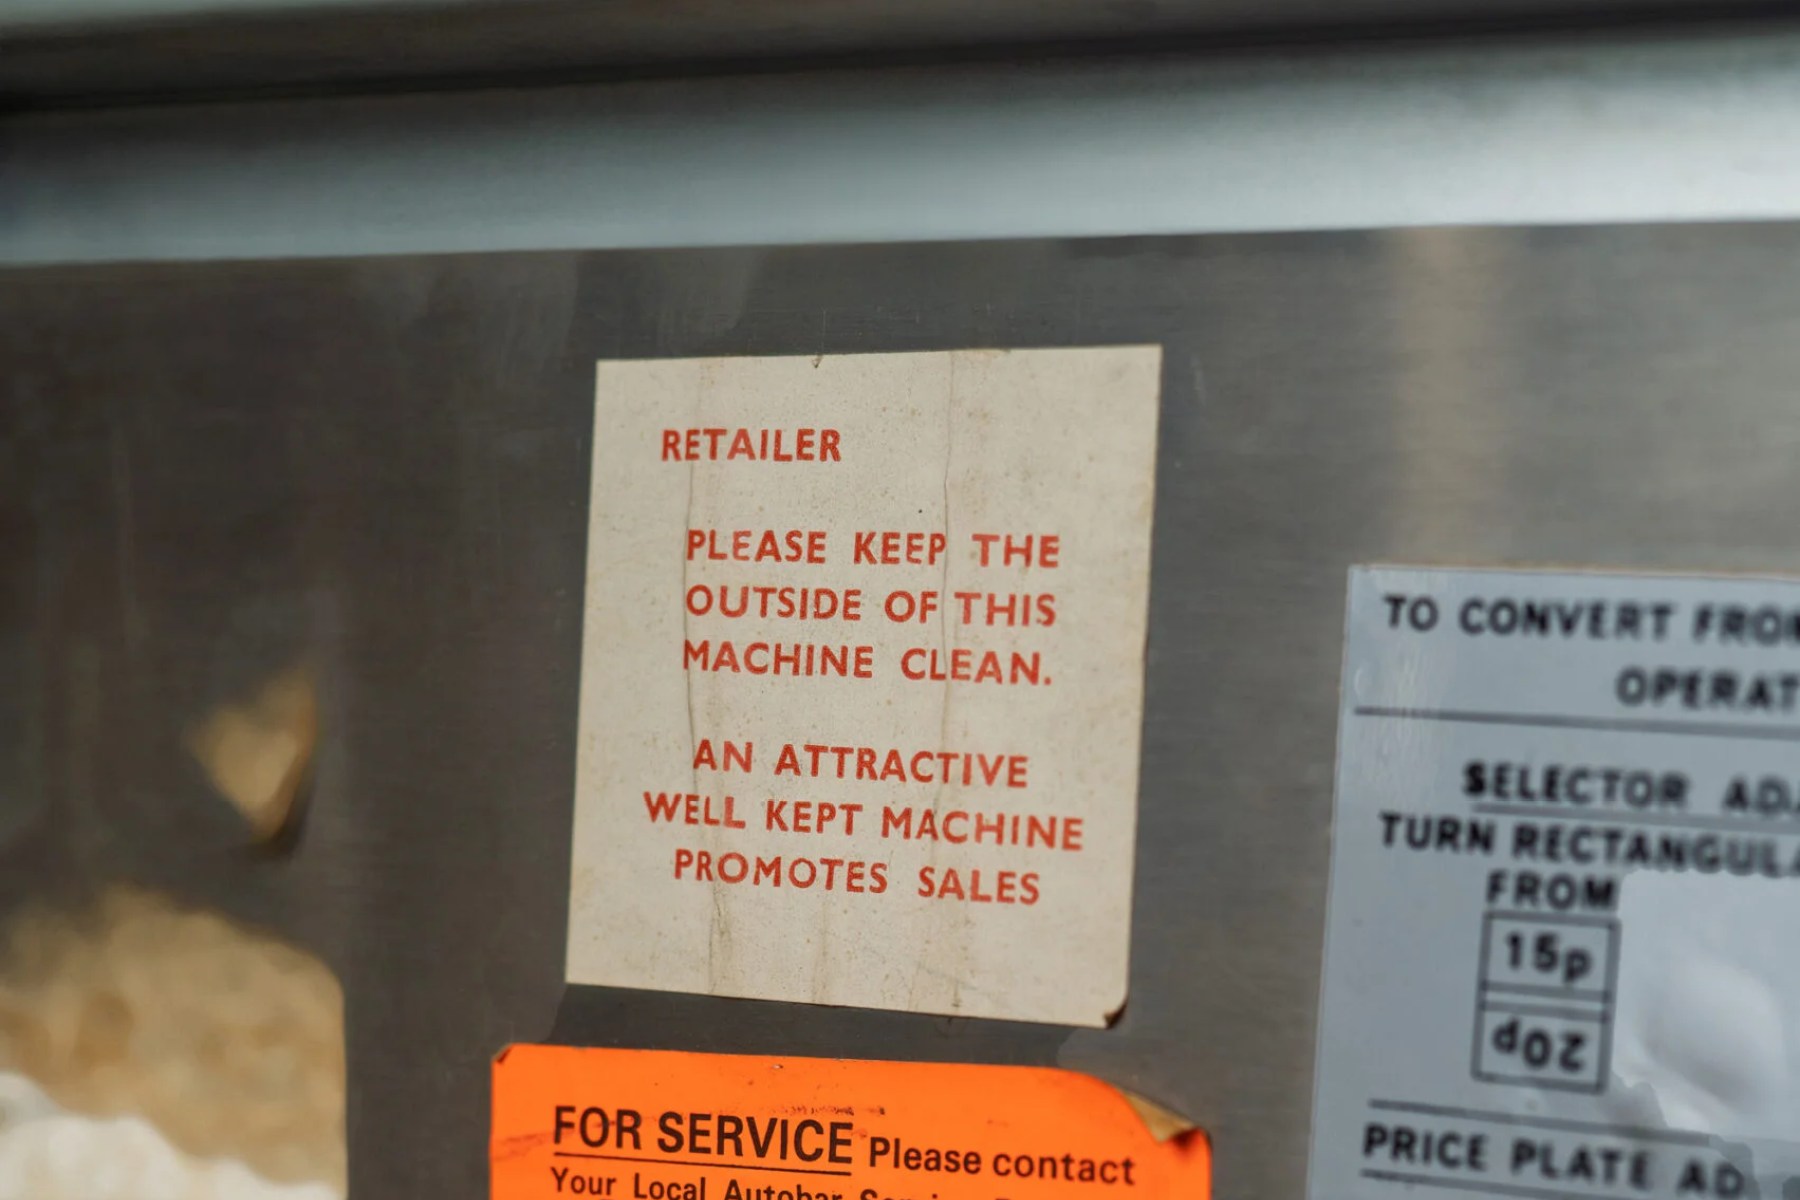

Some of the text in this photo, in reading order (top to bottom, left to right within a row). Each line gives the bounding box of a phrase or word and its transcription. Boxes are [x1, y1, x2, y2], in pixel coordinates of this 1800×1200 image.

[661, 428, 842, 462] RETAILER
[686, 529, 1061, 569] PLEASE KEEP THE
[684, 584, 1056, 627] OUTSIDE OF THIS
[1385, 594, 1439, 632] TO
[1458, 598, 1674, 640] CONVERT
[683, 640, 1053, 686] MACHINE CLEAN.
[692, 739, 1028, 789] AN ATTRACTIVE
[1462, 761, 1800, 818] SELECTOR AD
[643, 791, 1084, 851] WELL KEPT MACHINE
[1379, 810, 1496, 856] TURN
[674, 849, 1040, 905] PROMOTES SALES
[1486, 870, 1617, 912] FROM
[1505, 931, 1592, 983] 15p
[554, 1105, 1136, 1187] FOR SERVICE Please contact
[1363, 1122, 1488, 1172] PRICE
[1510, 1140, 1652, 1191] PLATE
[551, 1166, 616, 1196] Your
